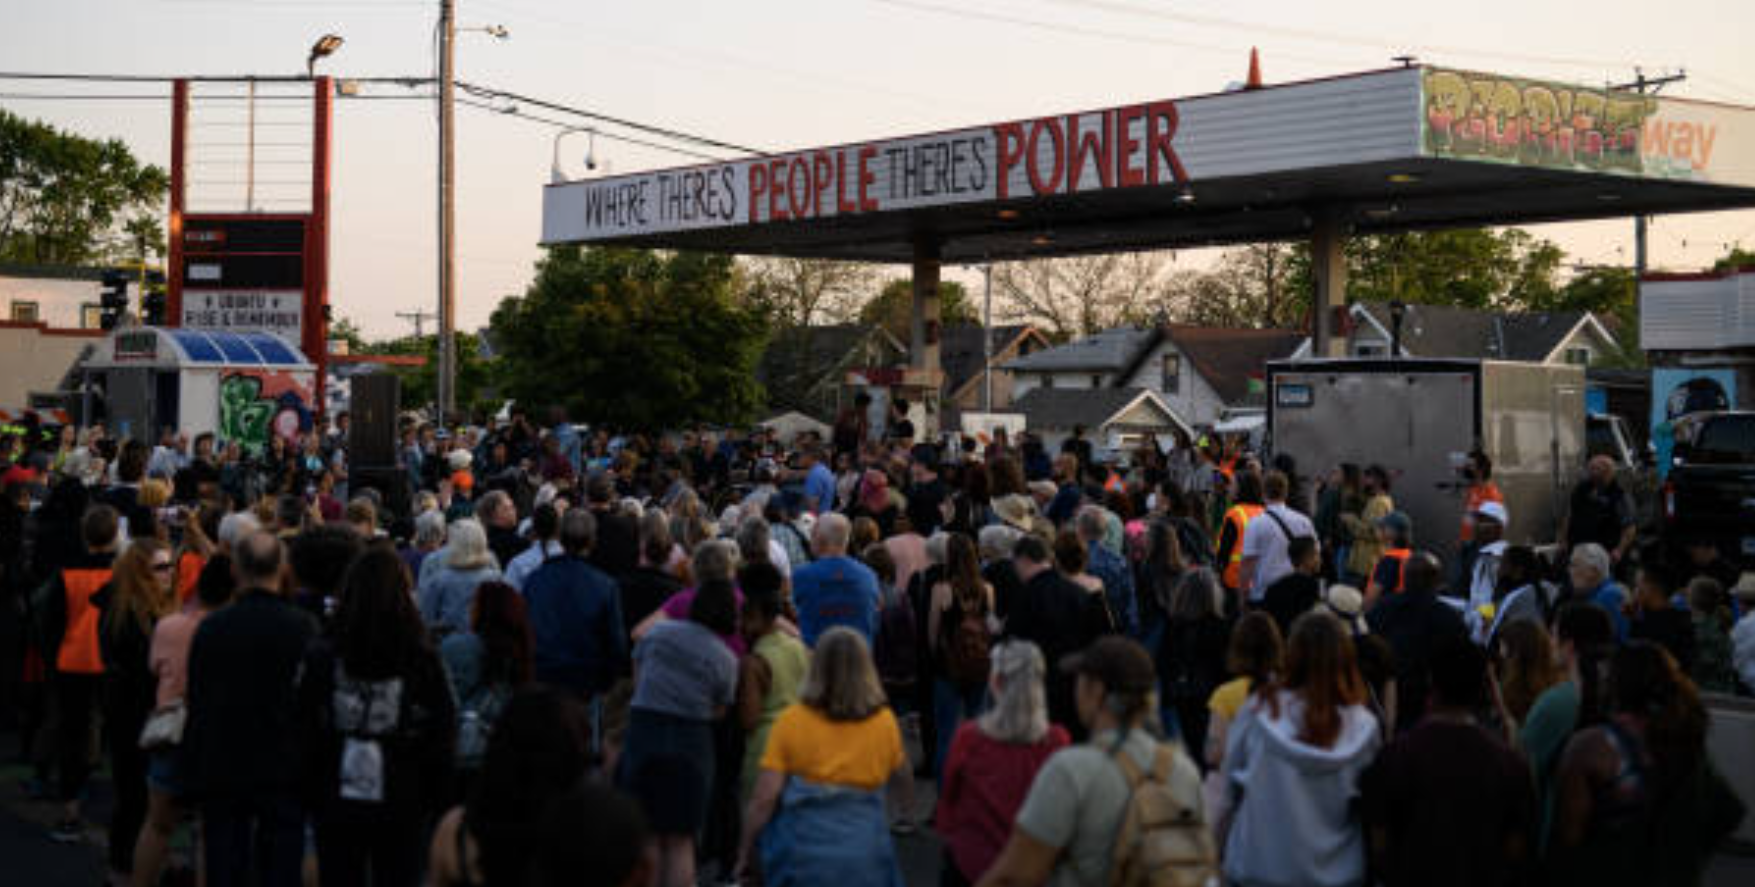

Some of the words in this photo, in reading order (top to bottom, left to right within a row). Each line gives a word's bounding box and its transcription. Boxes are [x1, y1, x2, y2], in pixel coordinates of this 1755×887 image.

[585, 177, 648, 230] WHERE
[657, 164, 736, 225] THERES
[748, 145, 878, 223] PEOPLE
[885, 135, 986, 200] THERES
[993, 99, 1187, 199] POWER
[1642, 117, 1715, 170] way
